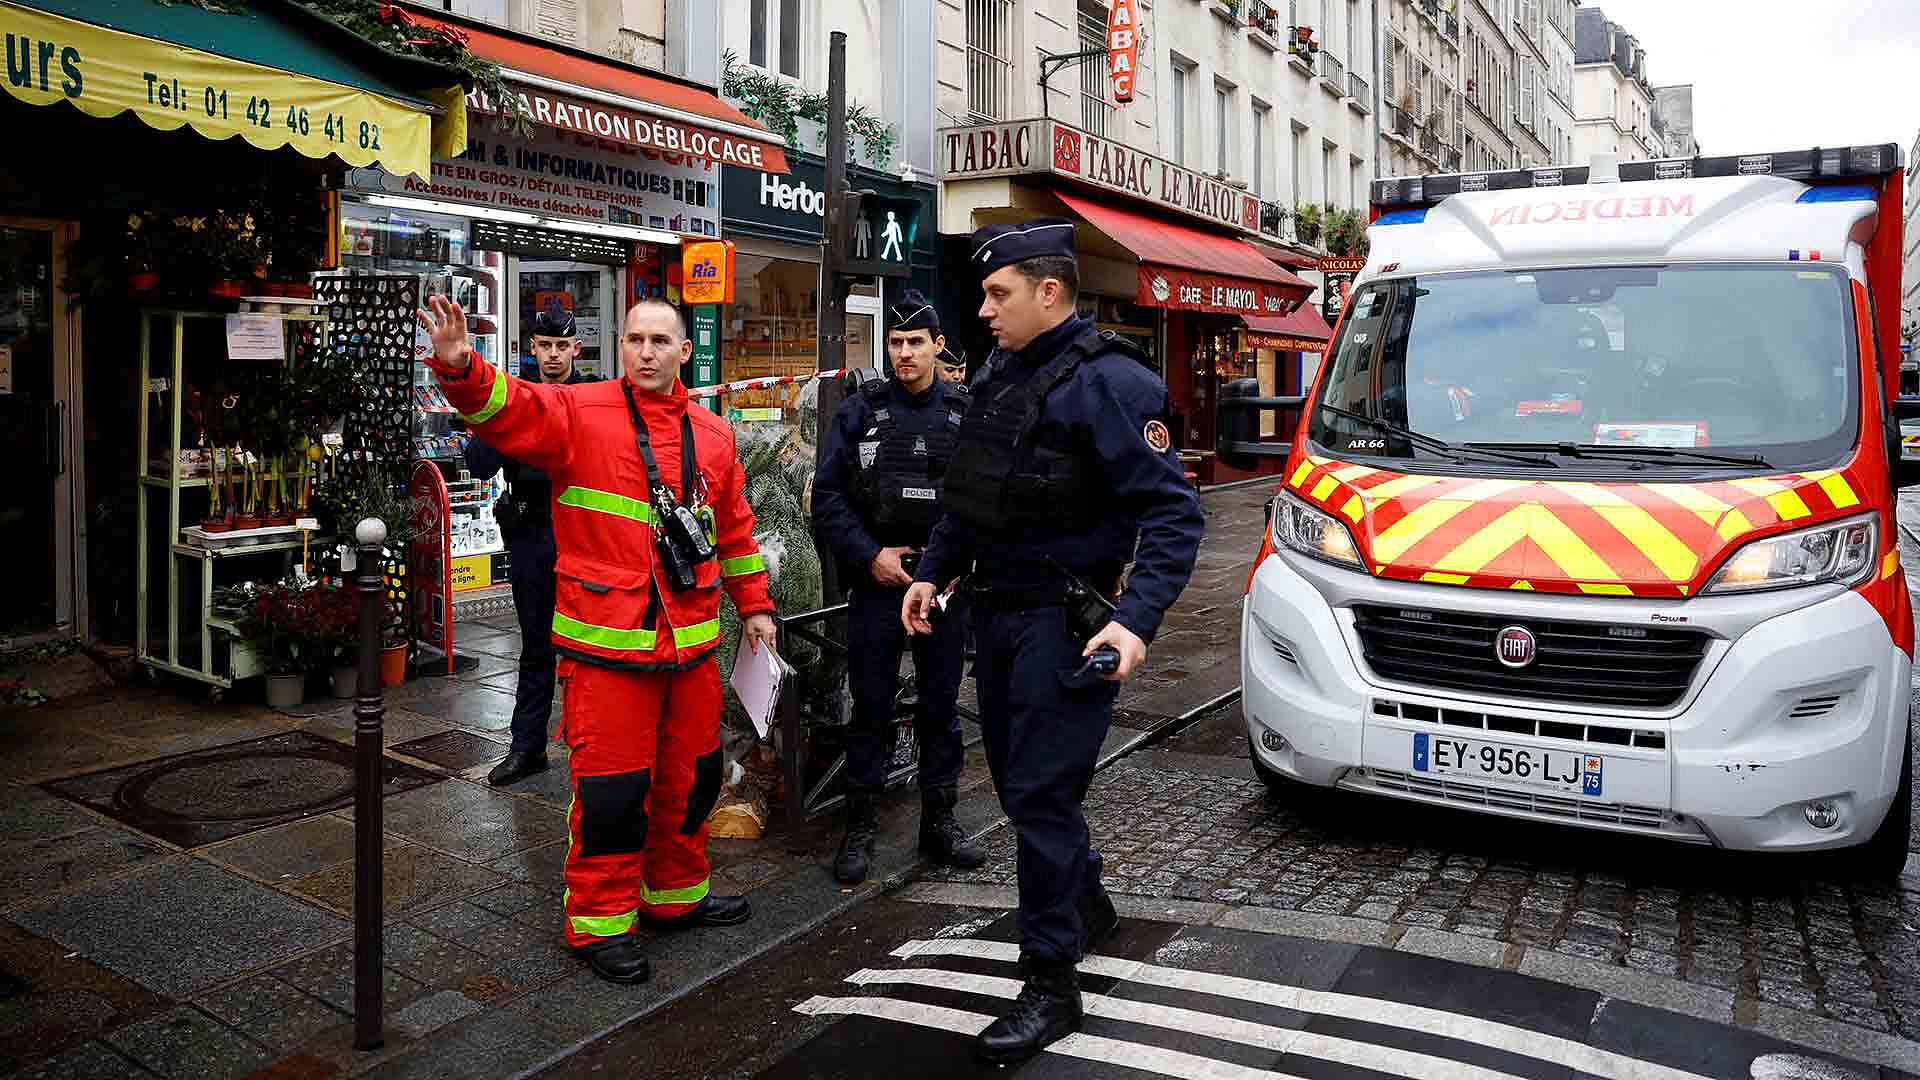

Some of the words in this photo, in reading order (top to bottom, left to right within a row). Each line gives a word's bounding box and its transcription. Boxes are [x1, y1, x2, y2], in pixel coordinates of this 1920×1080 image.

[6, 32, 83, 97] urs
[1111, 0, 1133, 95] ABAC
[143, 72, 187, 112] Tel:
[204, 85, 229, 121] 01
[246, 95, 271, 129] 42
[286, 105, 310, 136] 46
[324, 112, 345, 144] 41
[358, 120, 381, 151] 82
[464, 87, 630, 140] RARATION
[635, 116, 764, 167] DÉBLOCAGE
[516, 148, 671, 194] INFORMATIQUES
[946, 125, 1030, 174] TABAC
[403, 177, 489, 202] Accessoires
[500, 191, 541, 209] Pièces
[543, 199, 604, 218] détachées
[456, 166, 476, 182] EN
[479, 170, 517, 187] GROS
[527, 176, 575, 197] DÉTAIL
[575, 185, 644, 208] TELEPHONE
[1085, 135, 1153, 197] TABAC
[1160, 158, 1183, 207] LE
[1188, 168, 1241, 225] MAYOL
[692, 258, 718, 279] Ria
[1321, 259, 1364, 270] NICOLAS
[1179, 285, 1202, 304] CAFE
[1211, 285, 1223, 307] LE
[1225, 286, 1260, 310] MAYOL
[1348, 439, 1367, 449] AR
[1368, 439, 1385, 449] 66
[1503, 637, 1528, 657] FIAT
[1434, 739, 1580, 784] EY-956-LJ
[1585, 774, 1599, 789] 75
